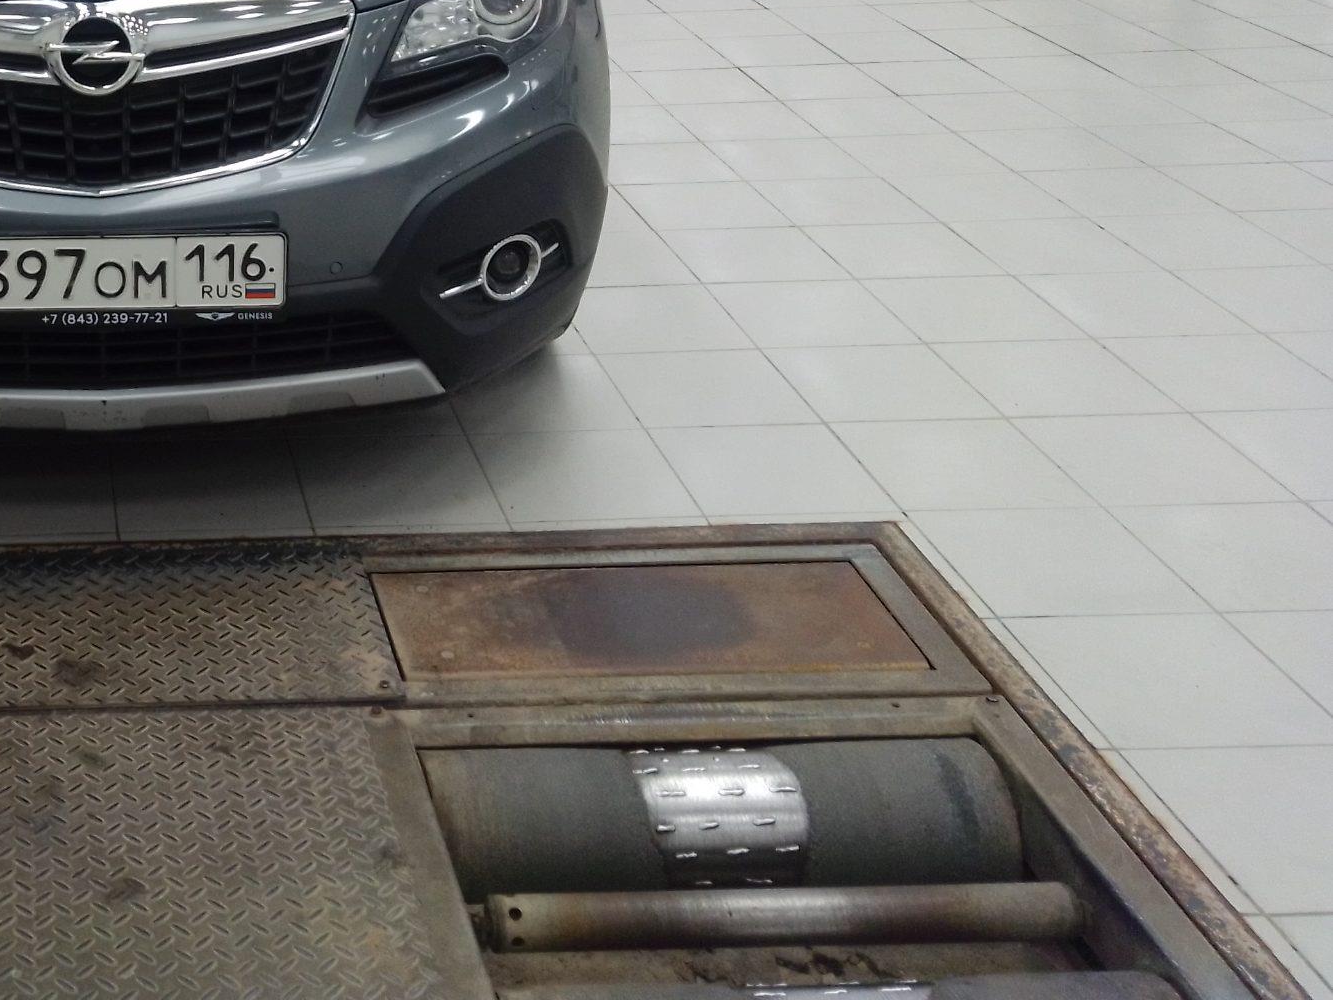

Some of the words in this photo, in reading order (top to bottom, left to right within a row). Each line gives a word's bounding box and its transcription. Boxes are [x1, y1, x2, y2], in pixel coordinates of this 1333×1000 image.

[184, 242, 267, 282] 116
[201, 284, 243, 299] RUS
[41, 313, 57, 325] +7
[61, 311, 99, 325] (843)
[103, 311, 168, 325] 239-77-21
[237, 311, 273, 321] GENESIS
